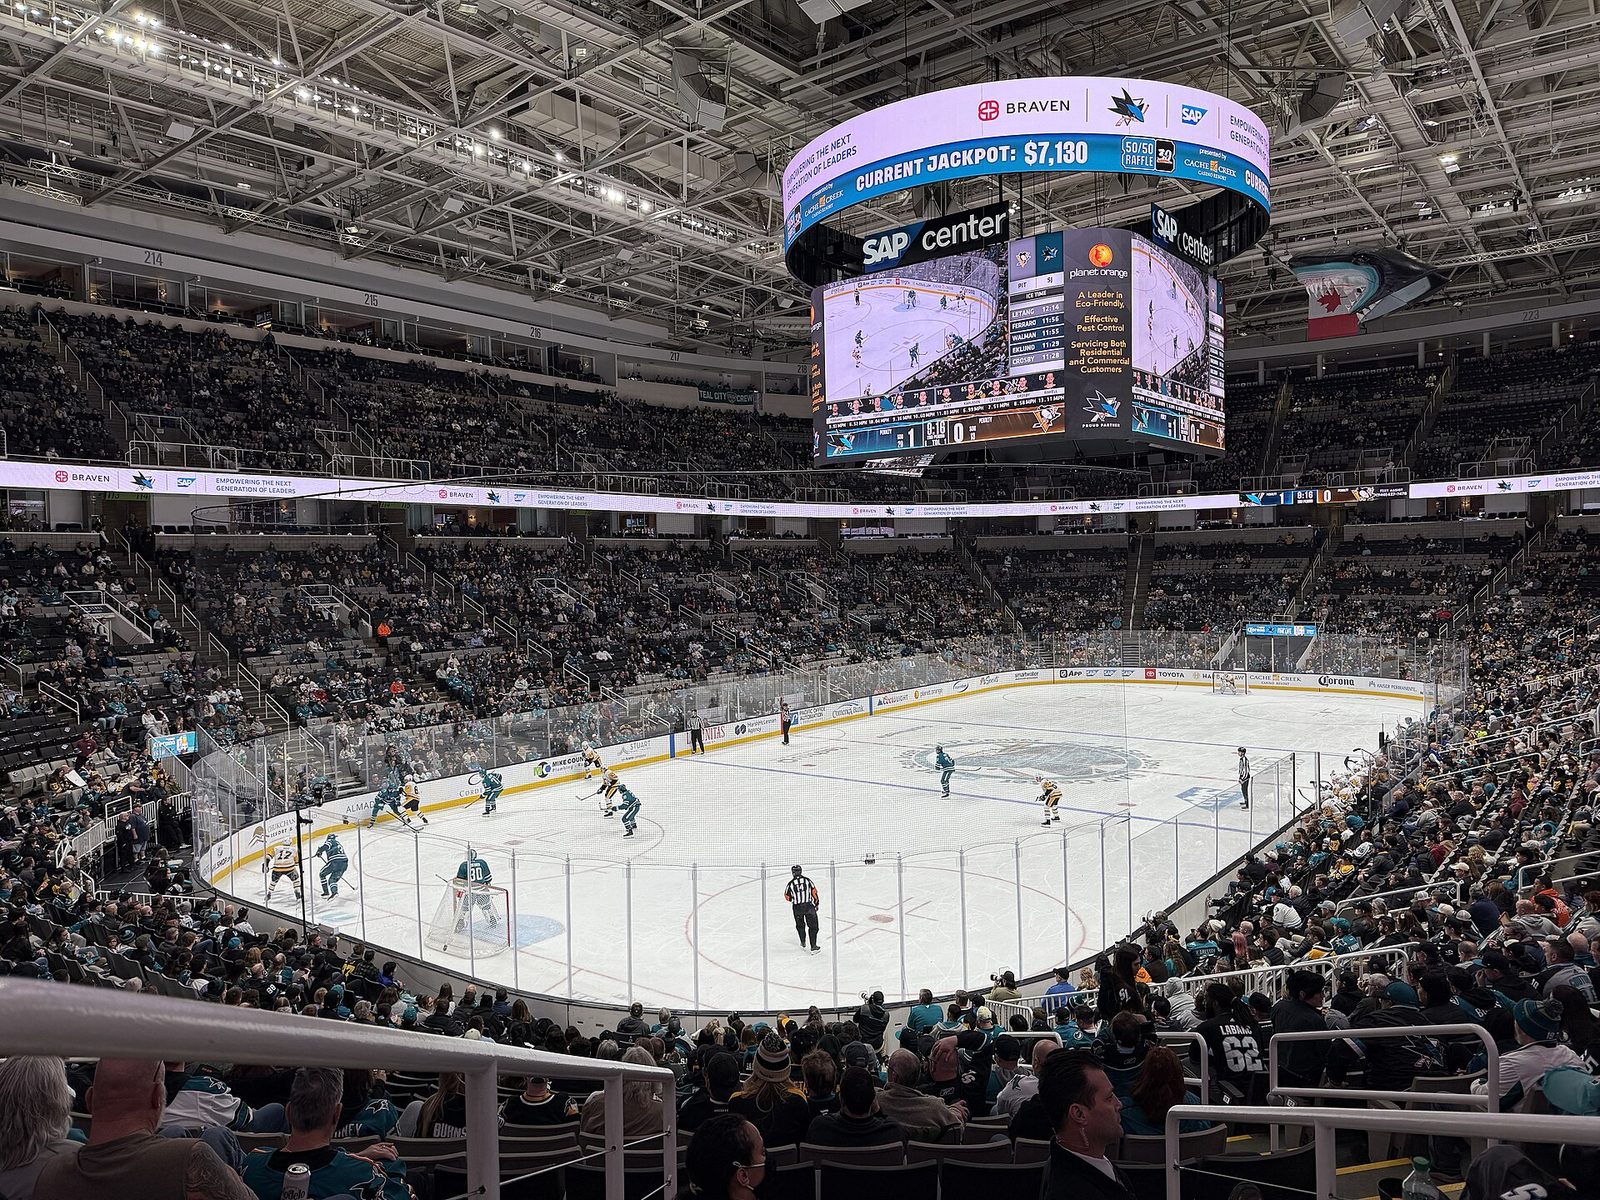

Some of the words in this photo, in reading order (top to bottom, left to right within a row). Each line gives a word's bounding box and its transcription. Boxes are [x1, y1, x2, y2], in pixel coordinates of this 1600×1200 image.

[1006, 100, 1070, 114] BRAVEN
[1182, 108, 1203, 122] SAP
[816, 144, 830, 160] THE
[830, 133, 851, 152] NEXT
[1125, 141, 1154, 155] 50/50
[813, 163, 823, 175] OF
[822, 145, 858, 170] LEADERS
[1126, 154, 1154, 167] RAFFLE
[1220, 153, 1227, 161] by
[856, 158, 924, 192] CURRENT
[927, 145, 1017, 172] JACKPOT:
[1024, 140, 1089, 167] $7,130
[1184, 158, 1209, 170] CACHE
[1217, 165, 1237, 178] CREEK
[825, 189, 844, 203] CREEK
[862, 231, 909, 265] SAP
[922, 212, 1007, 251] center
[1157, 209, 1178, 243] SAP
[1182, 231, 1213, 265] center
[144, 250, 164, 267] 214
[1069, 268, 1099, 279] planet
[1100, 269, 1128, 279] orange
[364, 292, 379, 307] 215
[1087, 291, 1114, 299] Leader
[1115, 291, 1123, 299] in
[1075, 300, 1125, 309] Eco-Friendly,
[1012, 308, 1035, 318] LETANG
[1042, 305, 1060, 313] 12:14
[1522, 310, 1540, 321] 223
[1012, 320, 1036, 330] FERRARO
[1042, 316, 1060, 324] 11:56
[1084, 315, 1119, 324] Effective
[530, 326, 542, 339] 216
[1076, 324, 1095, 332] Pest
[1097, 324, 1125, 332] Control
[1012, 332, 1037, 341] WALMAN
[1042, 329, 1060, 337] 11:55
[1012, 345, 1035, 353] EKLUND
[1042, 341, 1060, 349] 11:29
[1071, 340, 1109, 349] Servicing
[1110, 340, 1127, 348] Both
[670, 351, 680, 362] 217
[1080, 348, 1123, 356] Residential
[1012, 355, 1035, 365] CROSBY
[1069, 358, 1085, 366] and
[1087, 356, 1130, 365] Commercial
[700, 390, 714, 400] TEAL
[714, 392, 727, 400] CITY
[736, 394, 754, 402] CREW
[907, 428, 914, 448] 1
[953, 422, 964, 443] 0
[72, 473, 110, 483] BRAVEN
[177, 477, 193, 487] SAP
[216, 477, 261, 485] EMPOWERING
[216, 485, 258, 493] GENERATION
[449, 491, 474, 499] BRAVEN
[1279, 493, 1285, 505] 1
[1323, 489, 1332, 502] 0
[1317, 675, 1355, 687] Corona
[630, 740, 651, 750] STUART
[1219, 1024, 1253, 1036] LABANC
[1222, 1036, 1263, 1072] 62
[433, 1123, 467, 1138] BURNS
